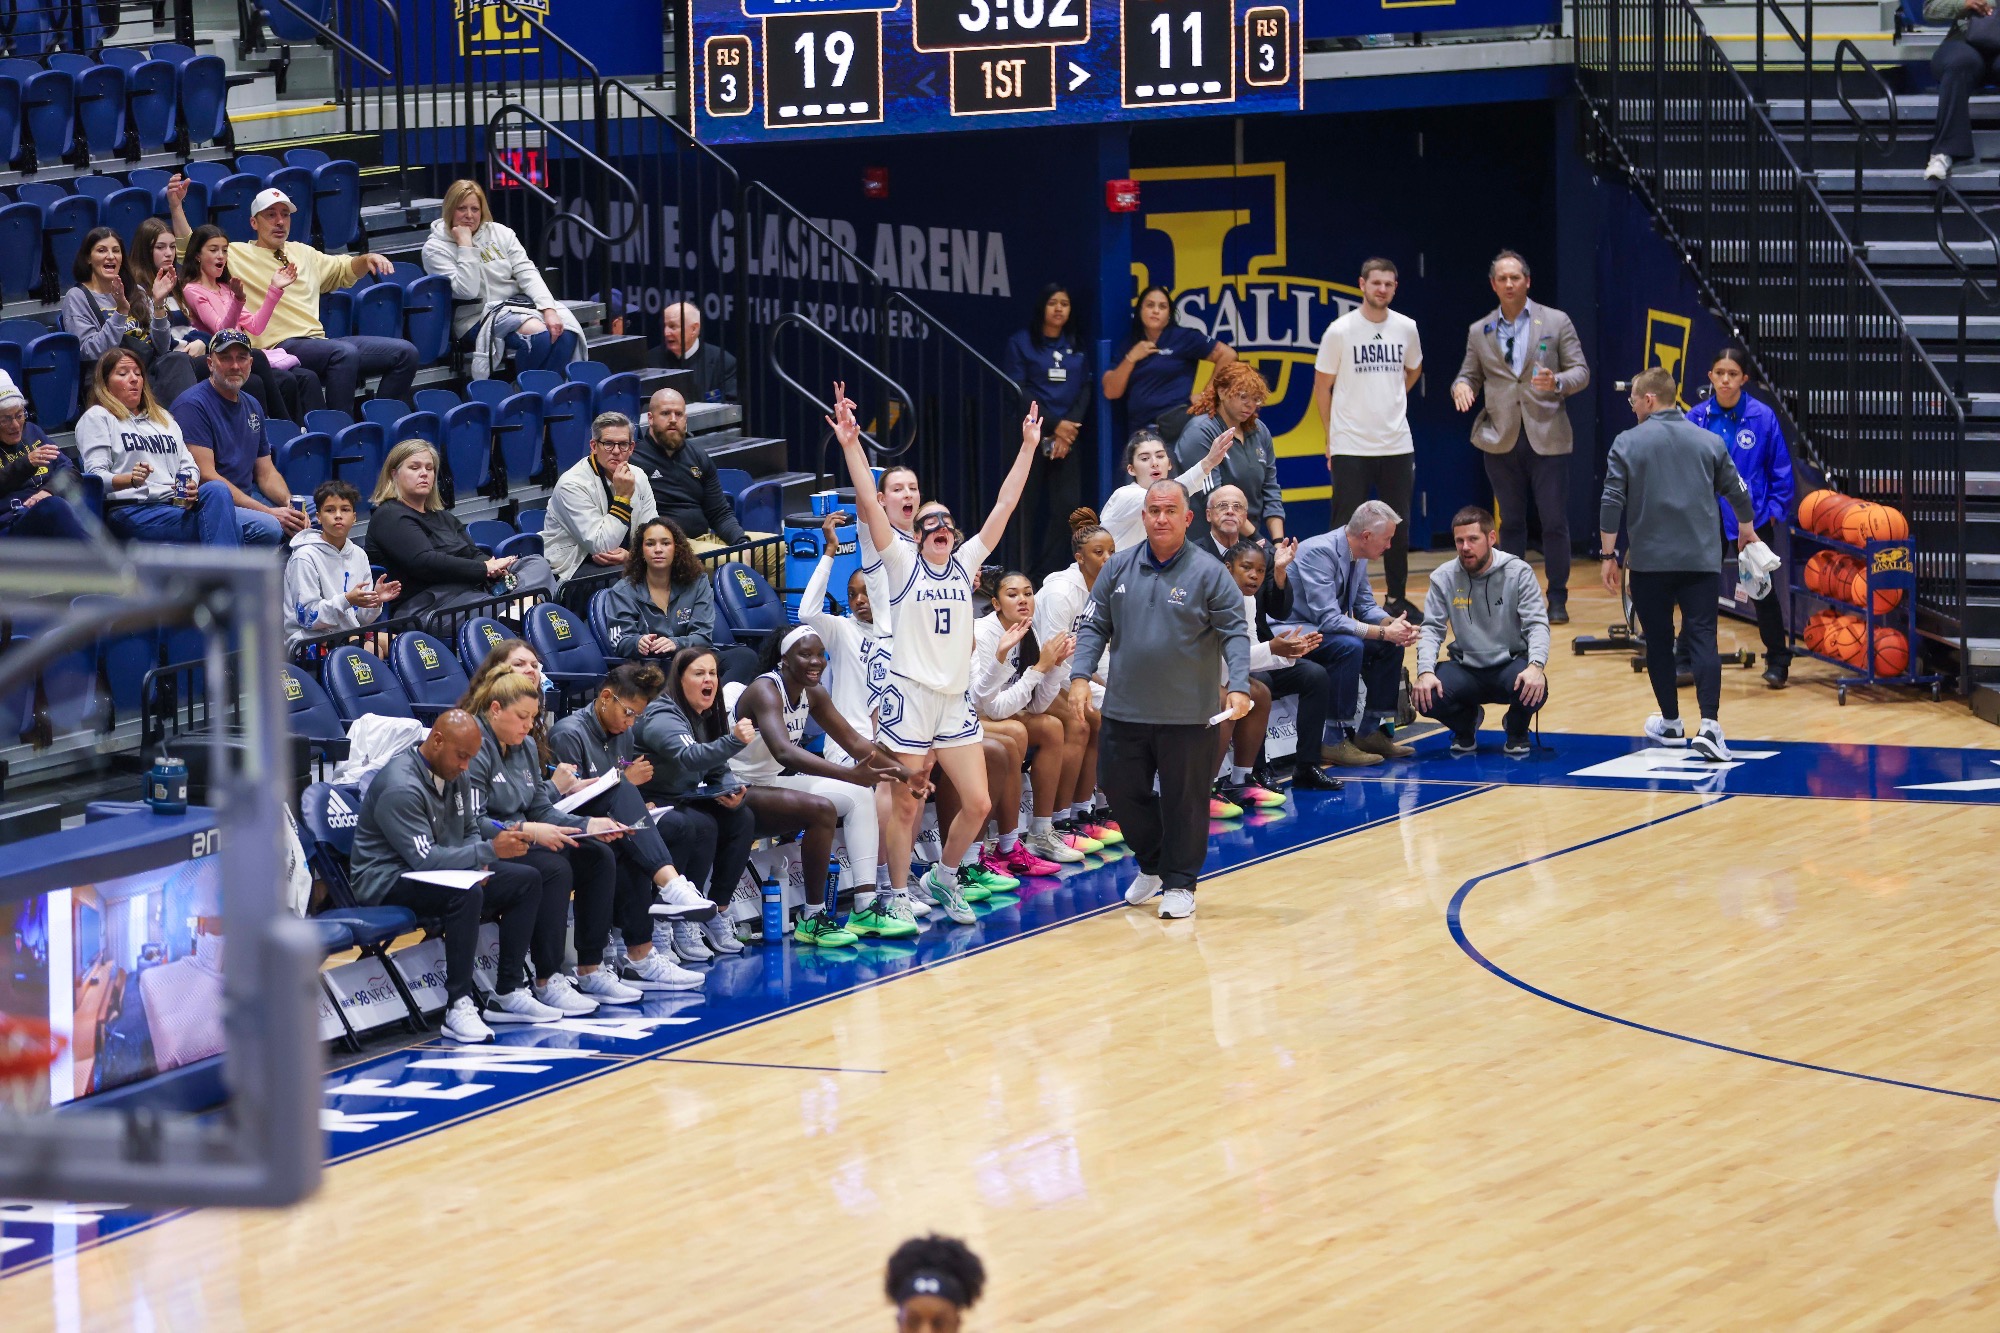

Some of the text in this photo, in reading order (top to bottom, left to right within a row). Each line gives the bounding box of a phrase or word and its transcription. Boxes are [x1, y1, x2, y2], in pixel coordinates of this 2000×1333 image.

[958, 0, 1078, 32] 3:02
[1257, 18, 1278, 37] FLS
[1151, 11, 1202, 69] 11
[717, 49, 740, 66] FLS
[795, 31, 855, 89] 19
[1259, 44, 1275, 72] 3
[720, 74, 737, 102] 3
[981, 59, 1026, 99] 1ST
[871, 223, 1011, 297] ARENA
[704, 292, 734, 321] OF
[1353, 344, 1403, 364] LASALLE
[835, 542, 857, 555] OWER
[916, 588, 967, 602] LASALLE
[934, 608, 951, 634] 13
[826, 873, 836, 910] POWERADE
[355, 990, 370, 1006] 98
[367, 982, 396, 1002] NECA
[422, 973, 437, 988] 98
